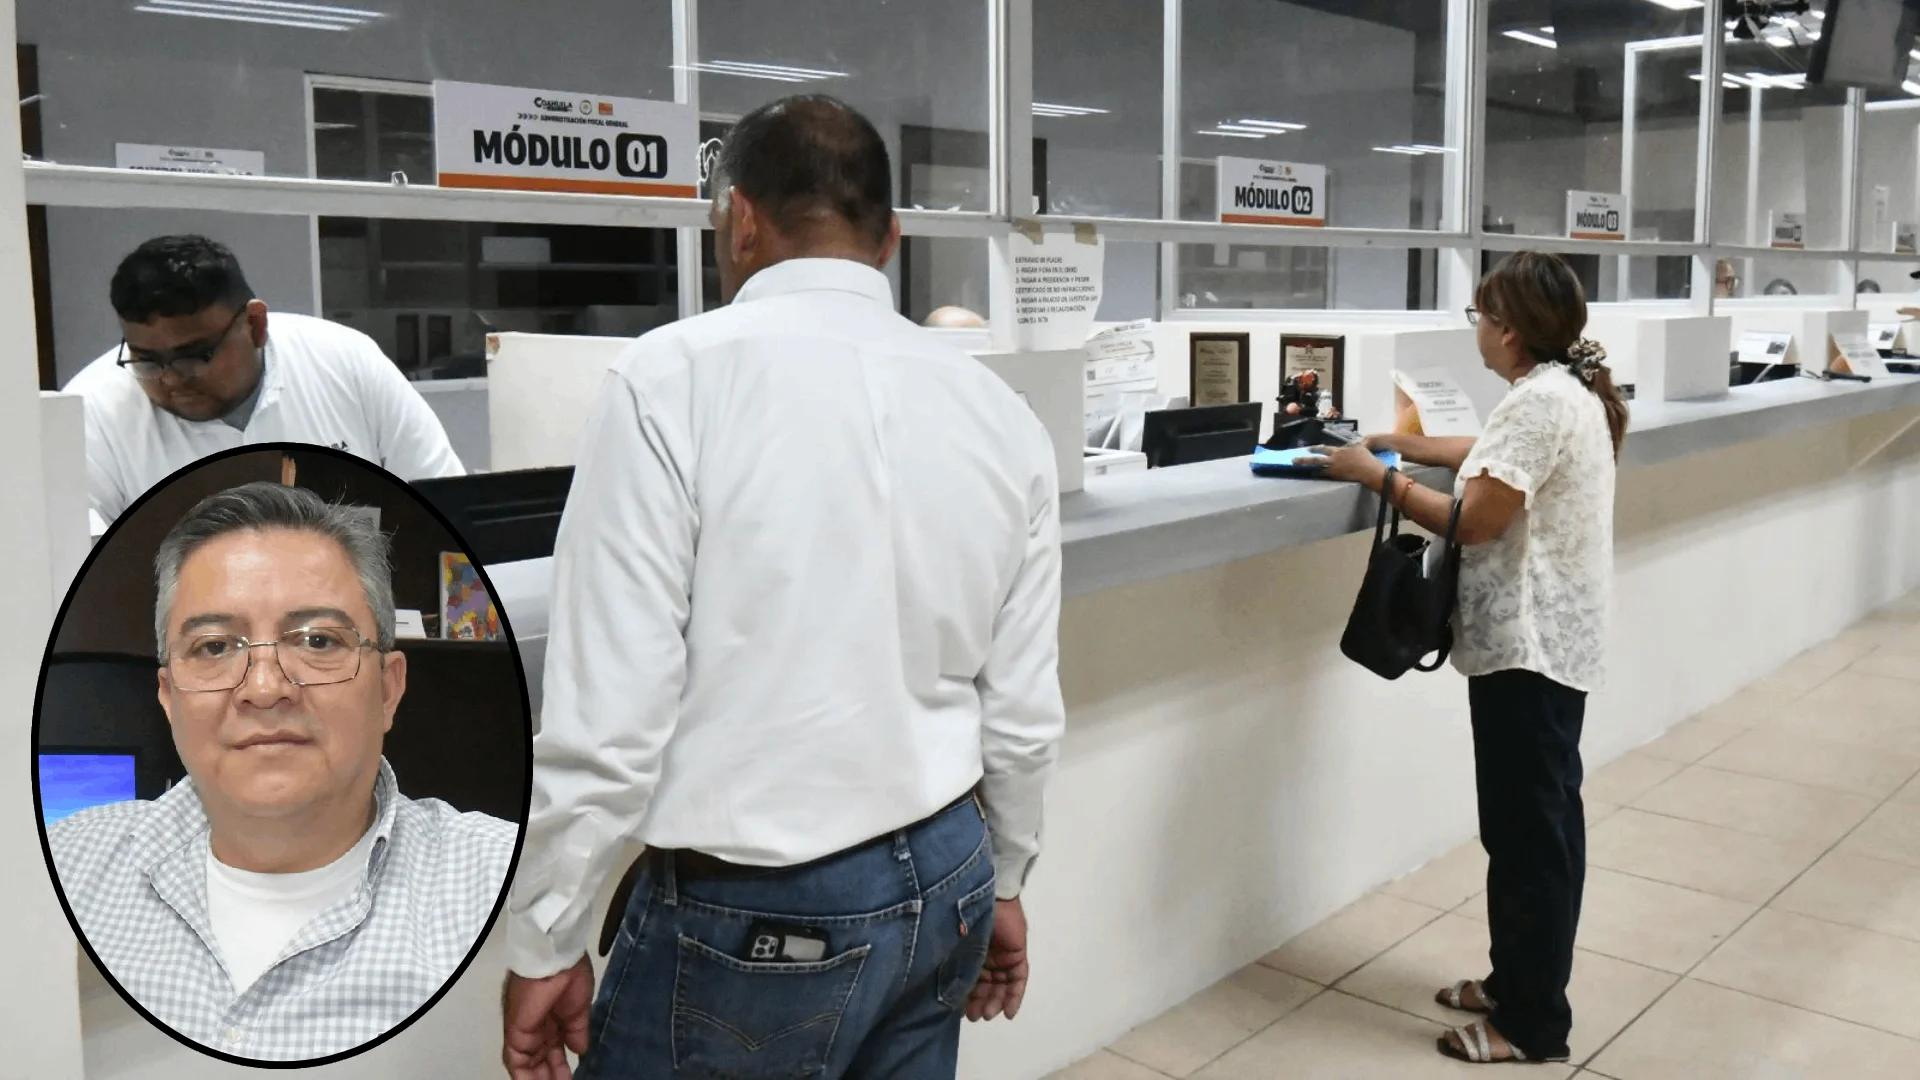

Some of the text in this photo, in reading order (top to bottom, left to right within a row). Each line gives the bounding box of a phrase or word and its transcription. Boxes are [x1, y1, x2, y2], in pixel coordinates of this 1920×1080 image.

[473, 125, 660, 174] MÓDULO 01
[1235, 182, 1311, 213] MÓDULO 02
[1576, 209, 1605, 229] MÓDULO
